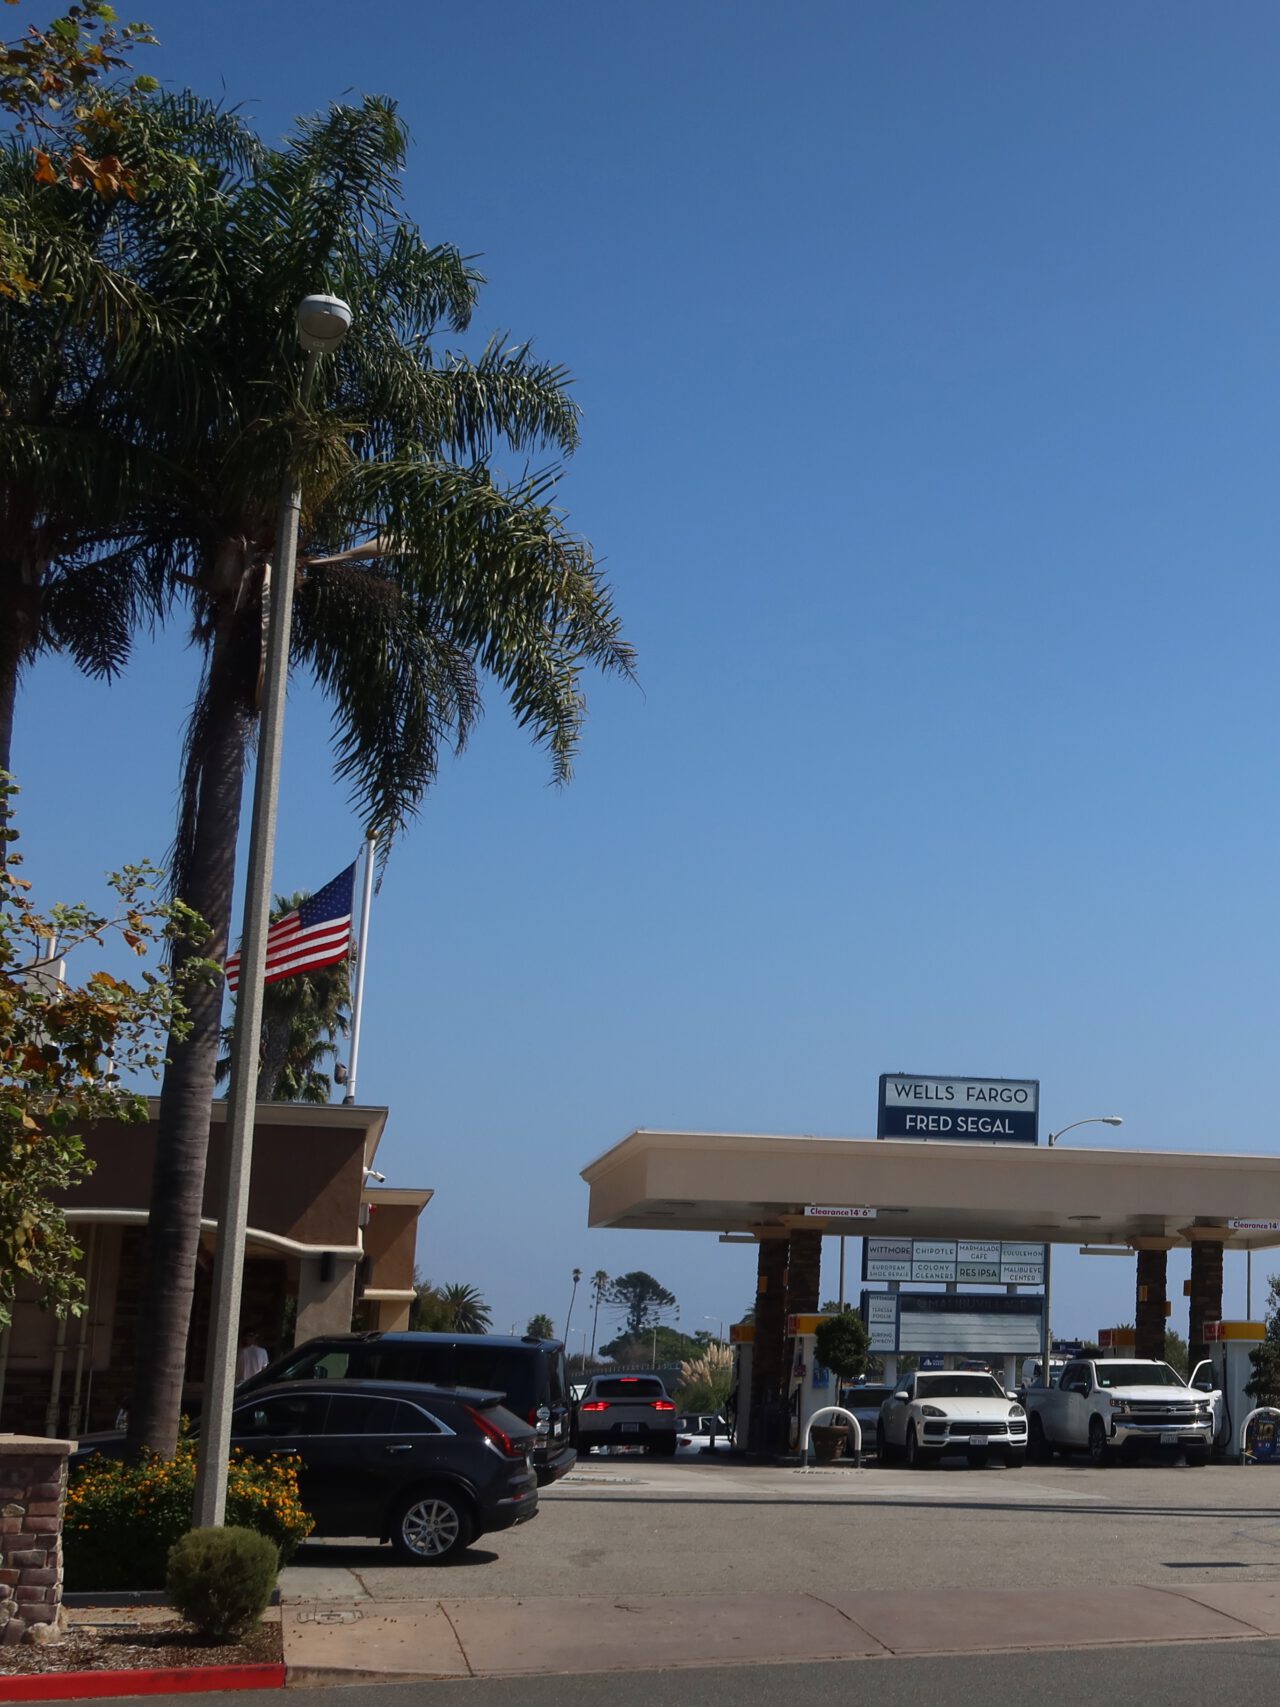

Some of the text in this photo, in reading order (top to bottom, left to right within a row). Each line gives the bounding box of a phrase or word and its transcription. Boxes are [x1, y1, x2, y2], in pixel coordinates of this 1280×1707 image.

[894, 1083, 1028, 1104] WELLS FARGO
[905, 1114, 1015, 1134] FRED SEGAL
[810, 1207, 849, 1216] Clearance
[1233, 1221, 1268, 1229] Clearance
[869, 1246, 912, 1256] WITTMORE
[915, 1247, 954, 1255] CHIPOTLE
[915, 1272, 954, 1280] CLEANERS
[959, 1268, 997, 1278] RES IPSA
